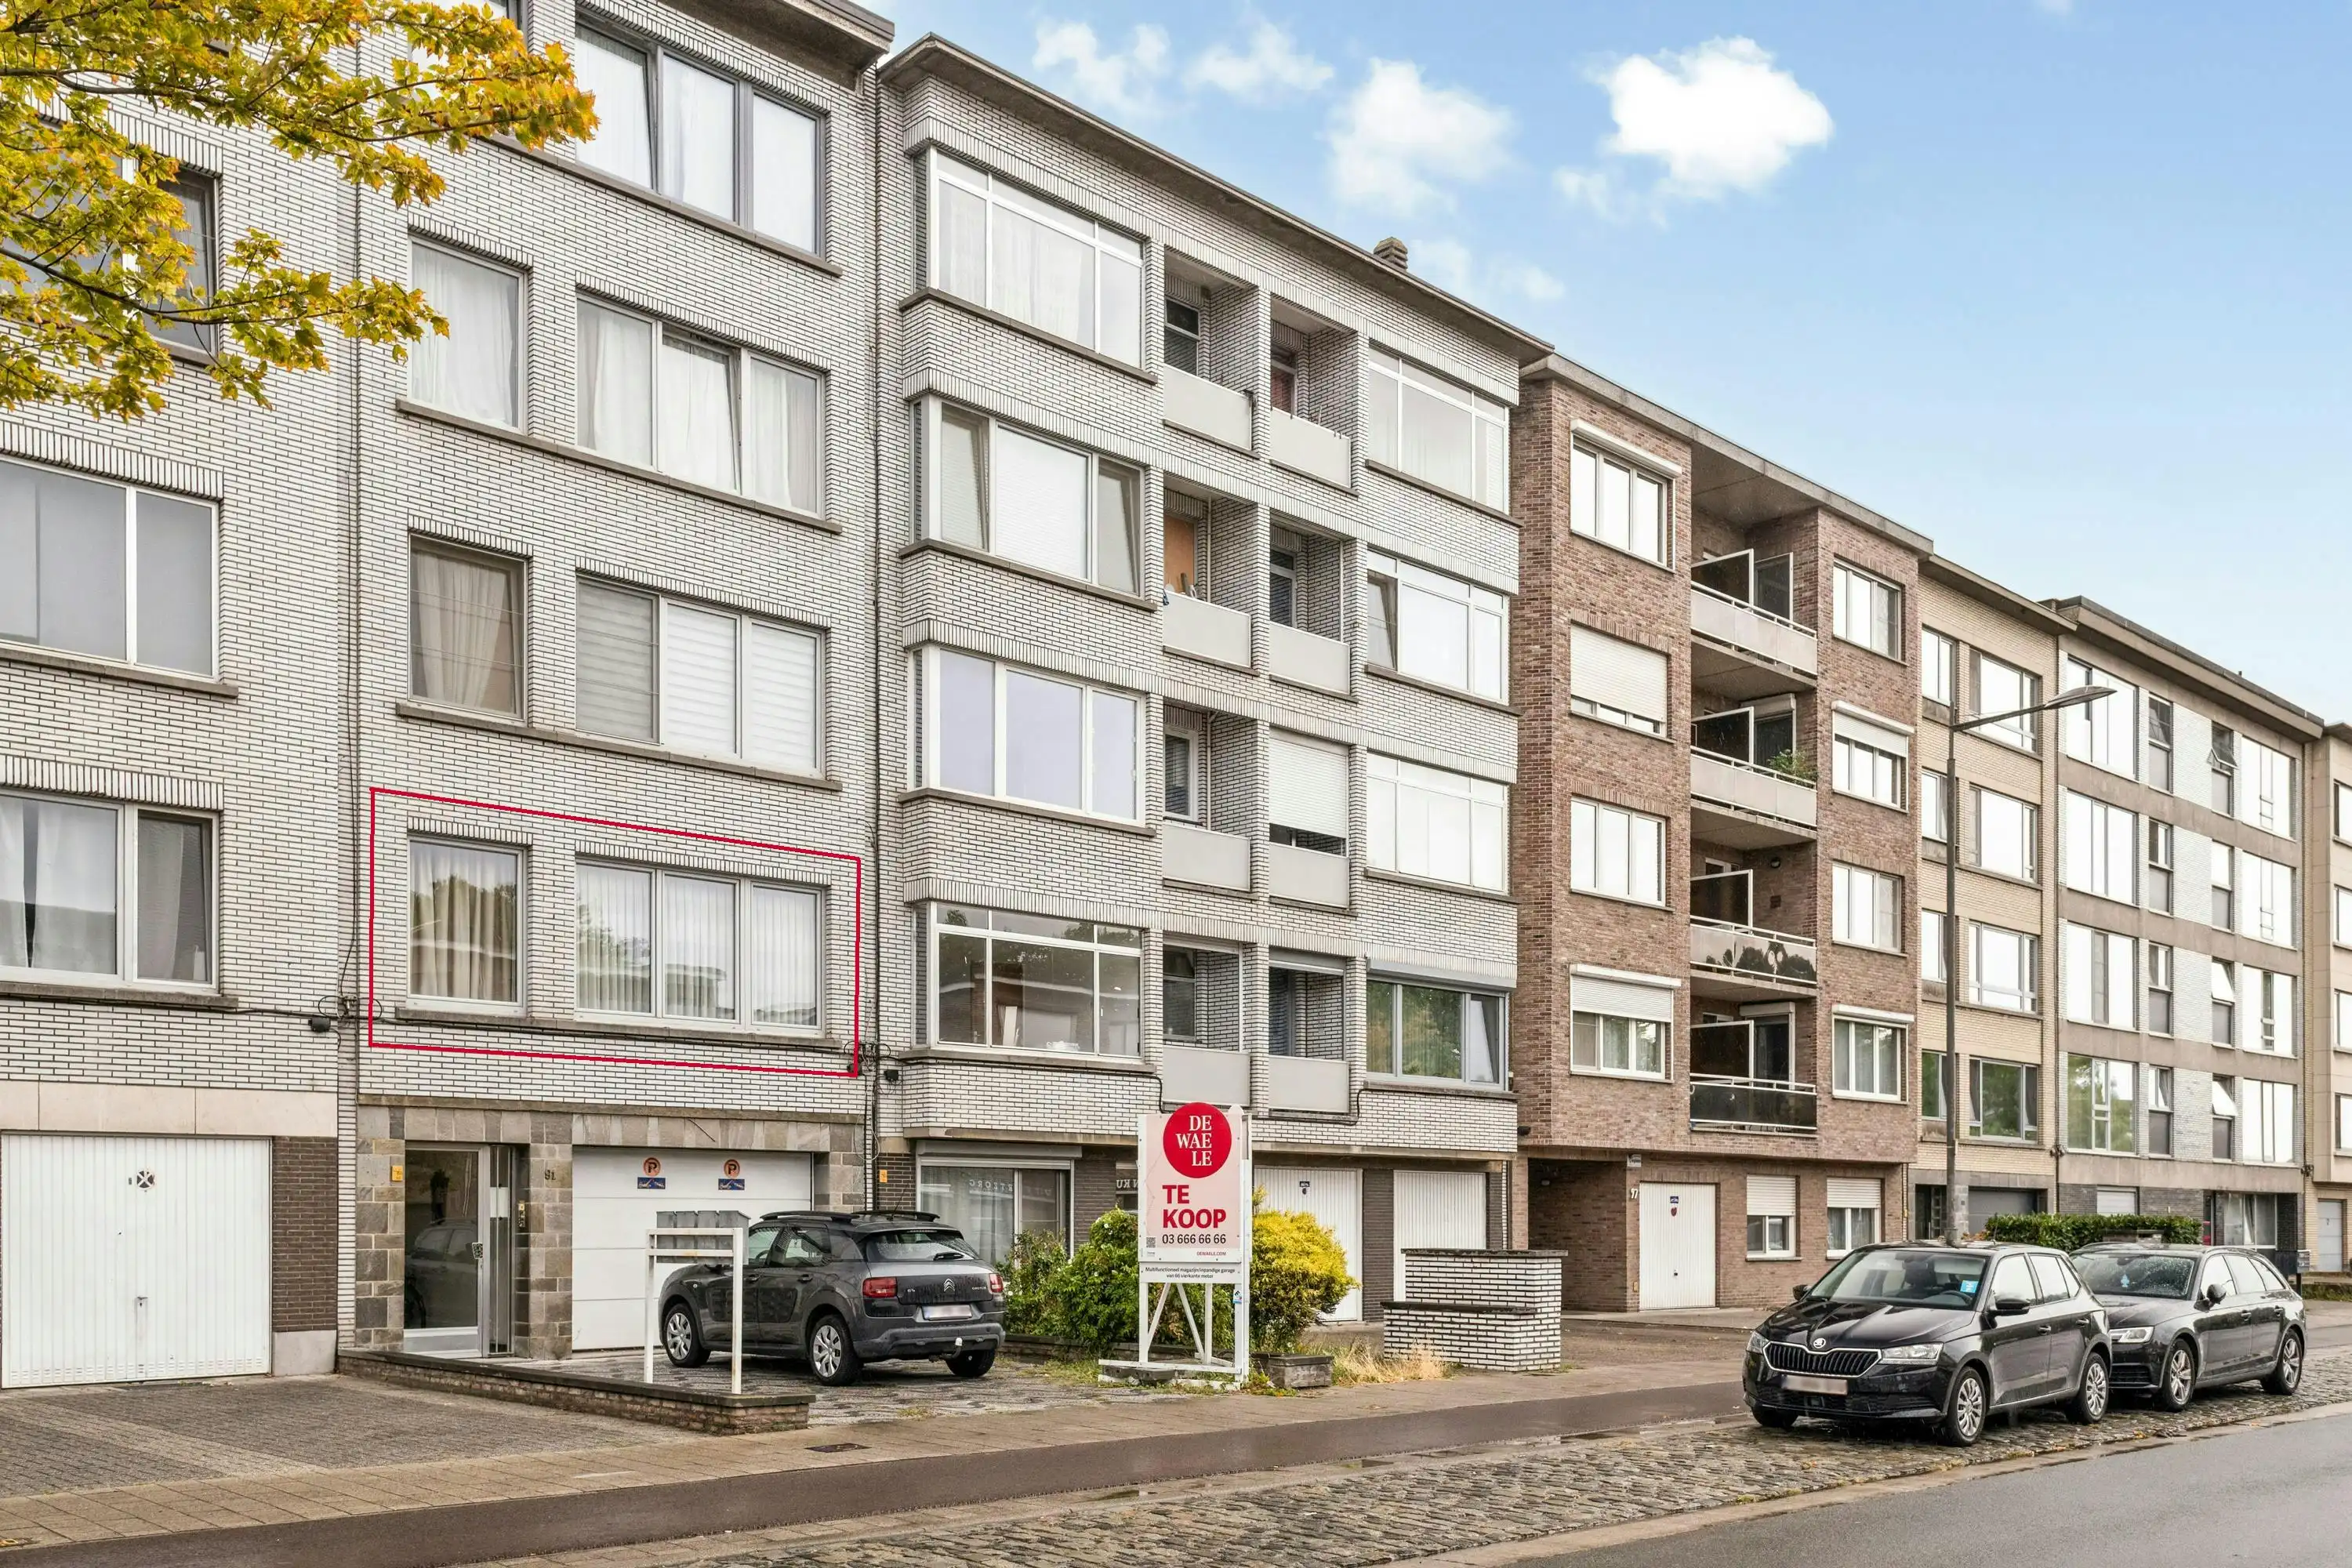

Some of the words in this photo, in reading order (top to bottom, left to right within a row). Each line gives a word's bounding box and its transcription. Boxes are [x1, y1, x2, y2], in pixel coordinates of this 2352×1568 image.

[1189, 1115, 1212, 1131] DE
[1176, 1133, 1212, 1149] WAE
[1192, 1151, 1212, 1167] LE
[1162, 1185, 1189, 1204] TE
[1163, 1209, 1226, 1229] KOOP
[1162, 1234, 1174, 1244] 03
[1177, 1234, 1196, 1244] 666
[1198, 1234, 1211, 1244] 66
[1213, 1234, 1226, 1244] 66
